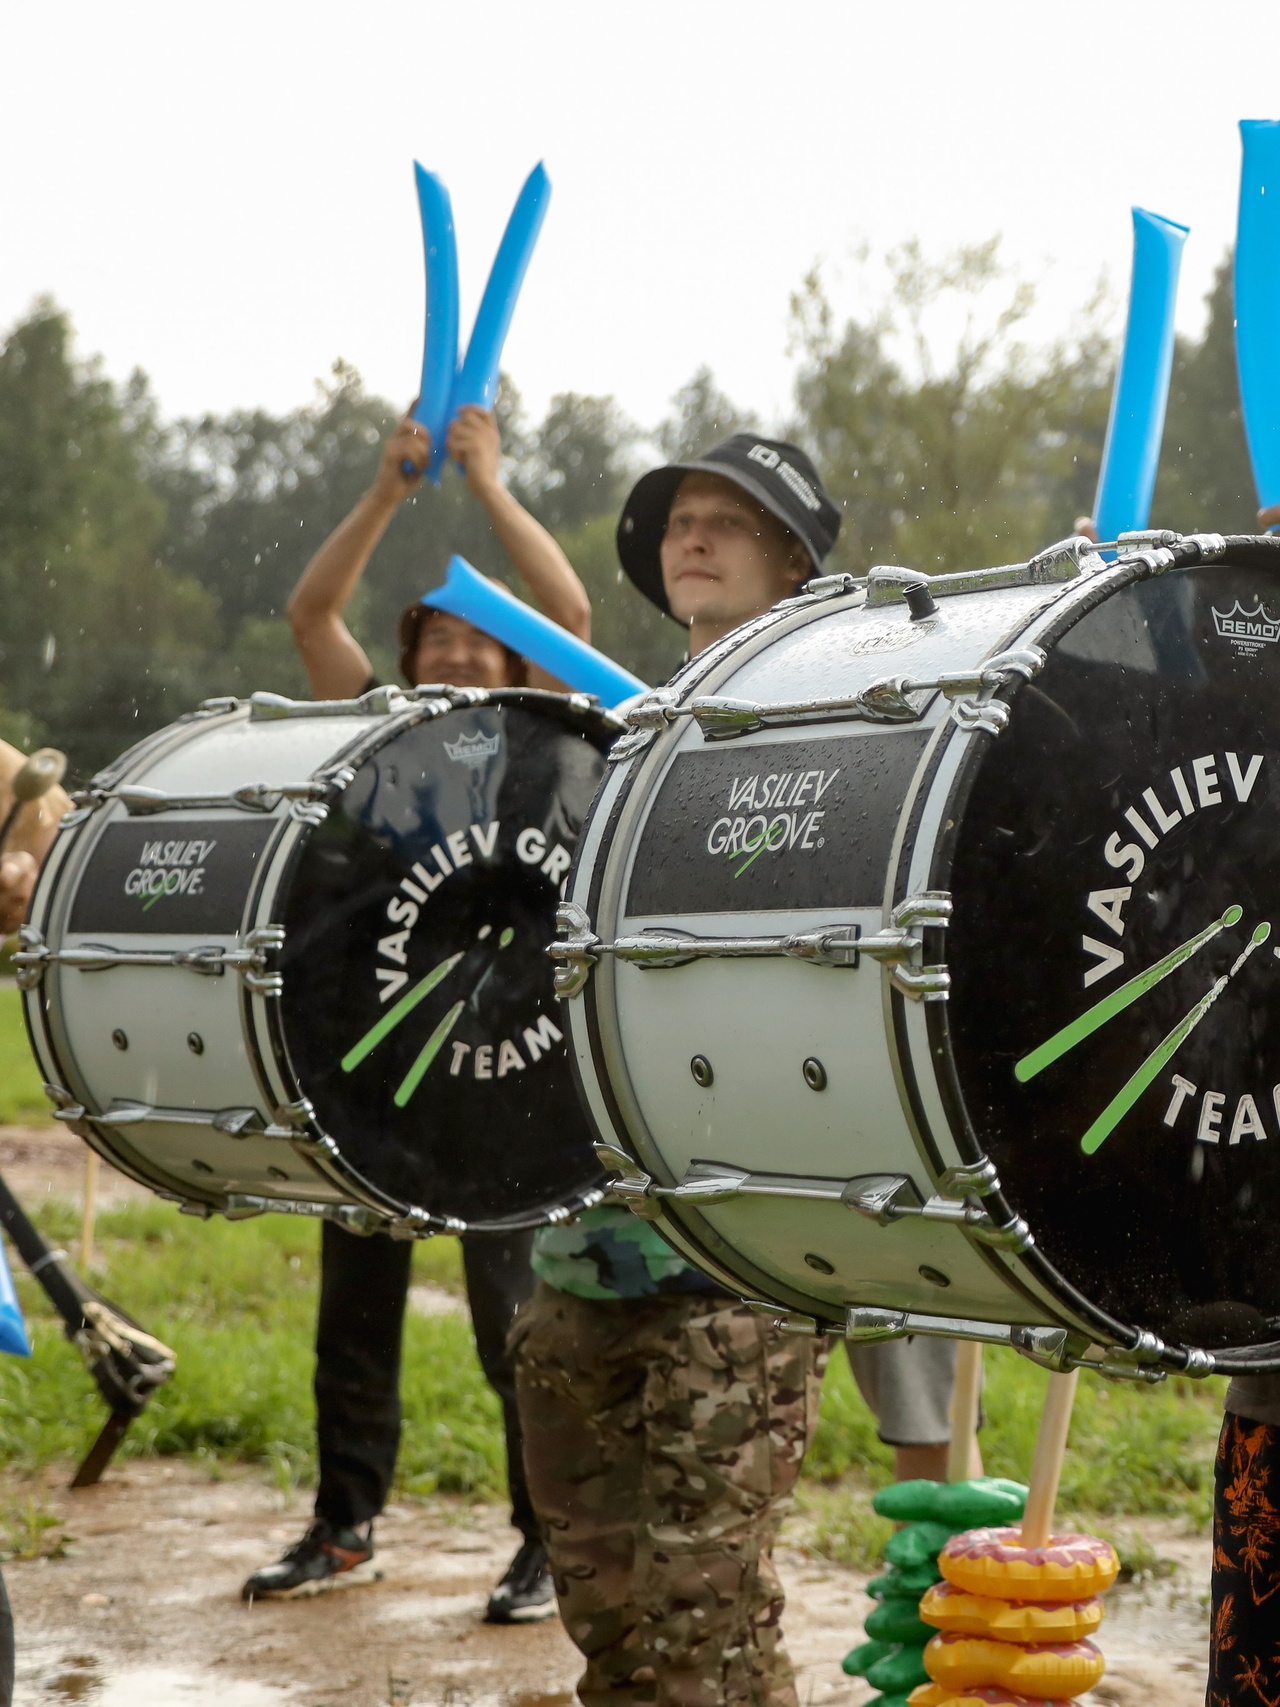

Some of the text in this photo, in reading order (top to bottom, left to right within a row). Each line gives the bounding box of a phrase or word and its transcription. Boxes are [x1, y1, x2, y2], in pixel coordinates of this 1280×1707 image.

[1222, 619, 1275, 637] REMO
[727, 768, 840, 811] VASILIEV
[140, 840, 217, 866] VASILIEV
[1082, 752, 1264, 988] VASILIEV
[375, 821, 500, 1003] VASILIEV
[450, 1014, 563, 1079] TEAM
